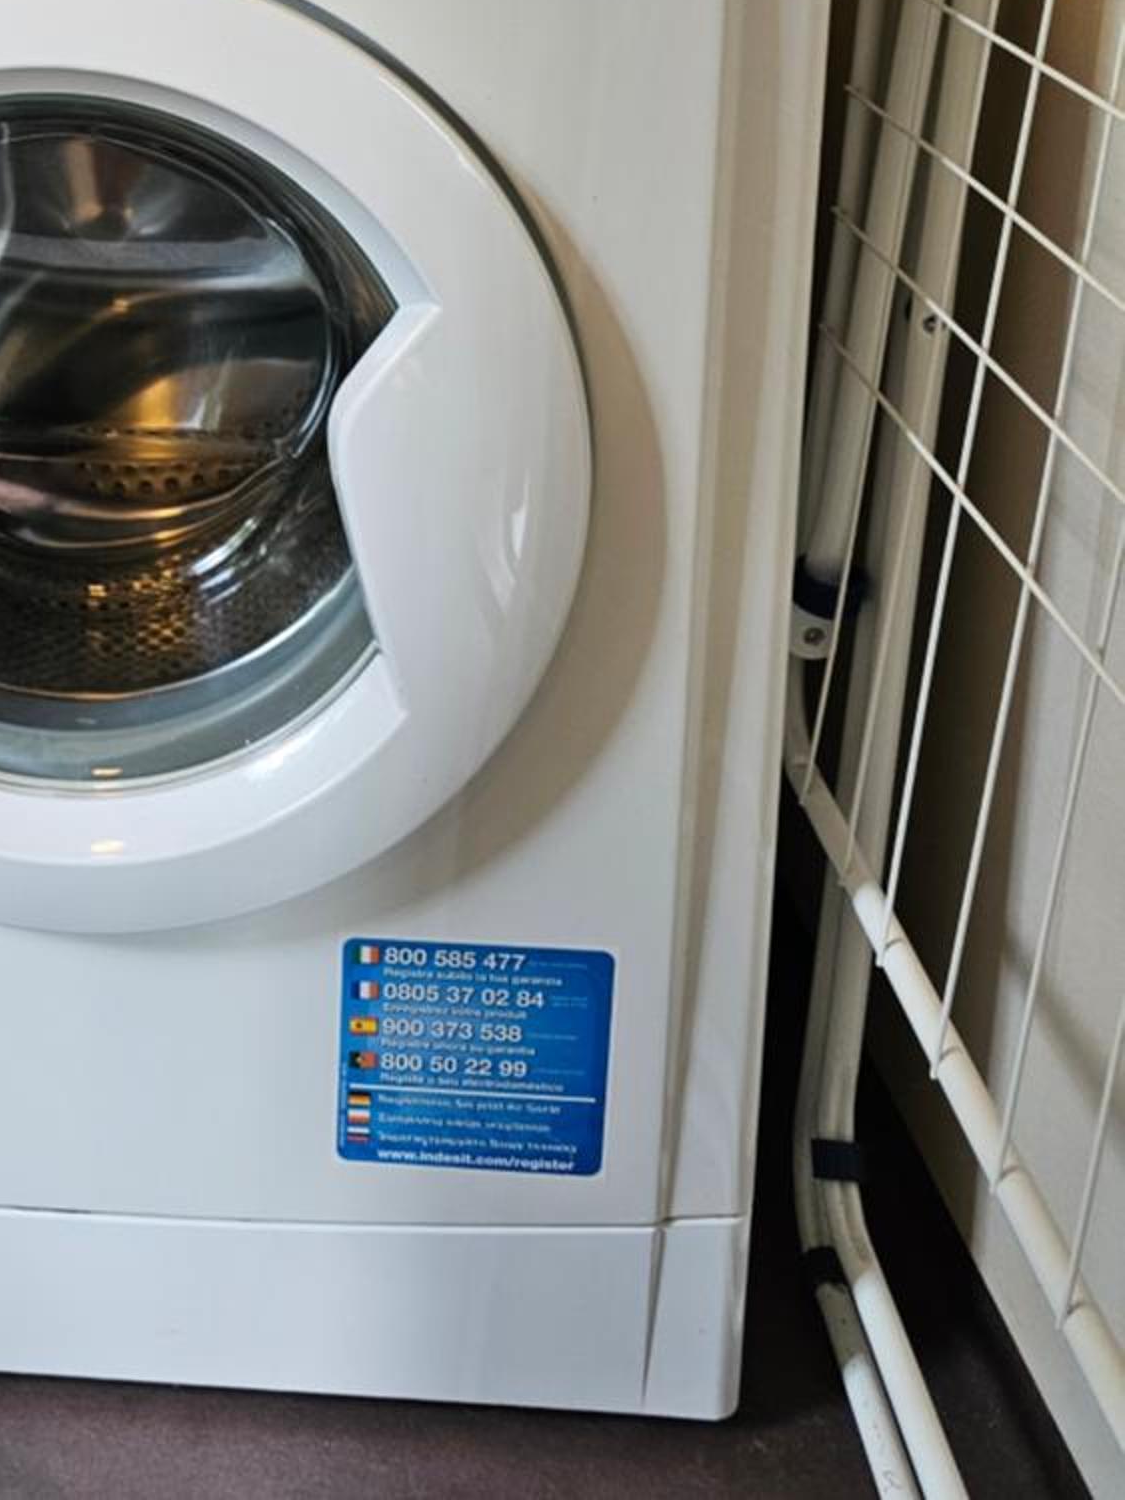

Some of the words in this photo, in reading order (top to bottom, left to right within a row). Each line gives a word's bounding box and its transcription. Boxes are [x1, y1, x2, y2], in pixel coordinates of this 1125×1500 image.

[383, 947, 426, 966] 800
[434, 949, 477, 969] 585
[483, 952, 525, 971] 477
[383, 983, 440, 1002] 0805
[446, 985, 475, 1004] 37
[481, 988, 510, 1007] 02
[516, 990, 544, 1010] 84
[382, 1017, 424, 1036] 900
[431, 1020, 473, 1039] 373
[480, 1023, 522, 1042] 538
[380, 1052, 423, 1072] 800
[429, 1055, 457, 1074] 50
[463, 1057, 491, 1076] 22
[498, 1060, 527, 1078] 99
[378, 1149, 575, 1171] www.indesit.com/register
